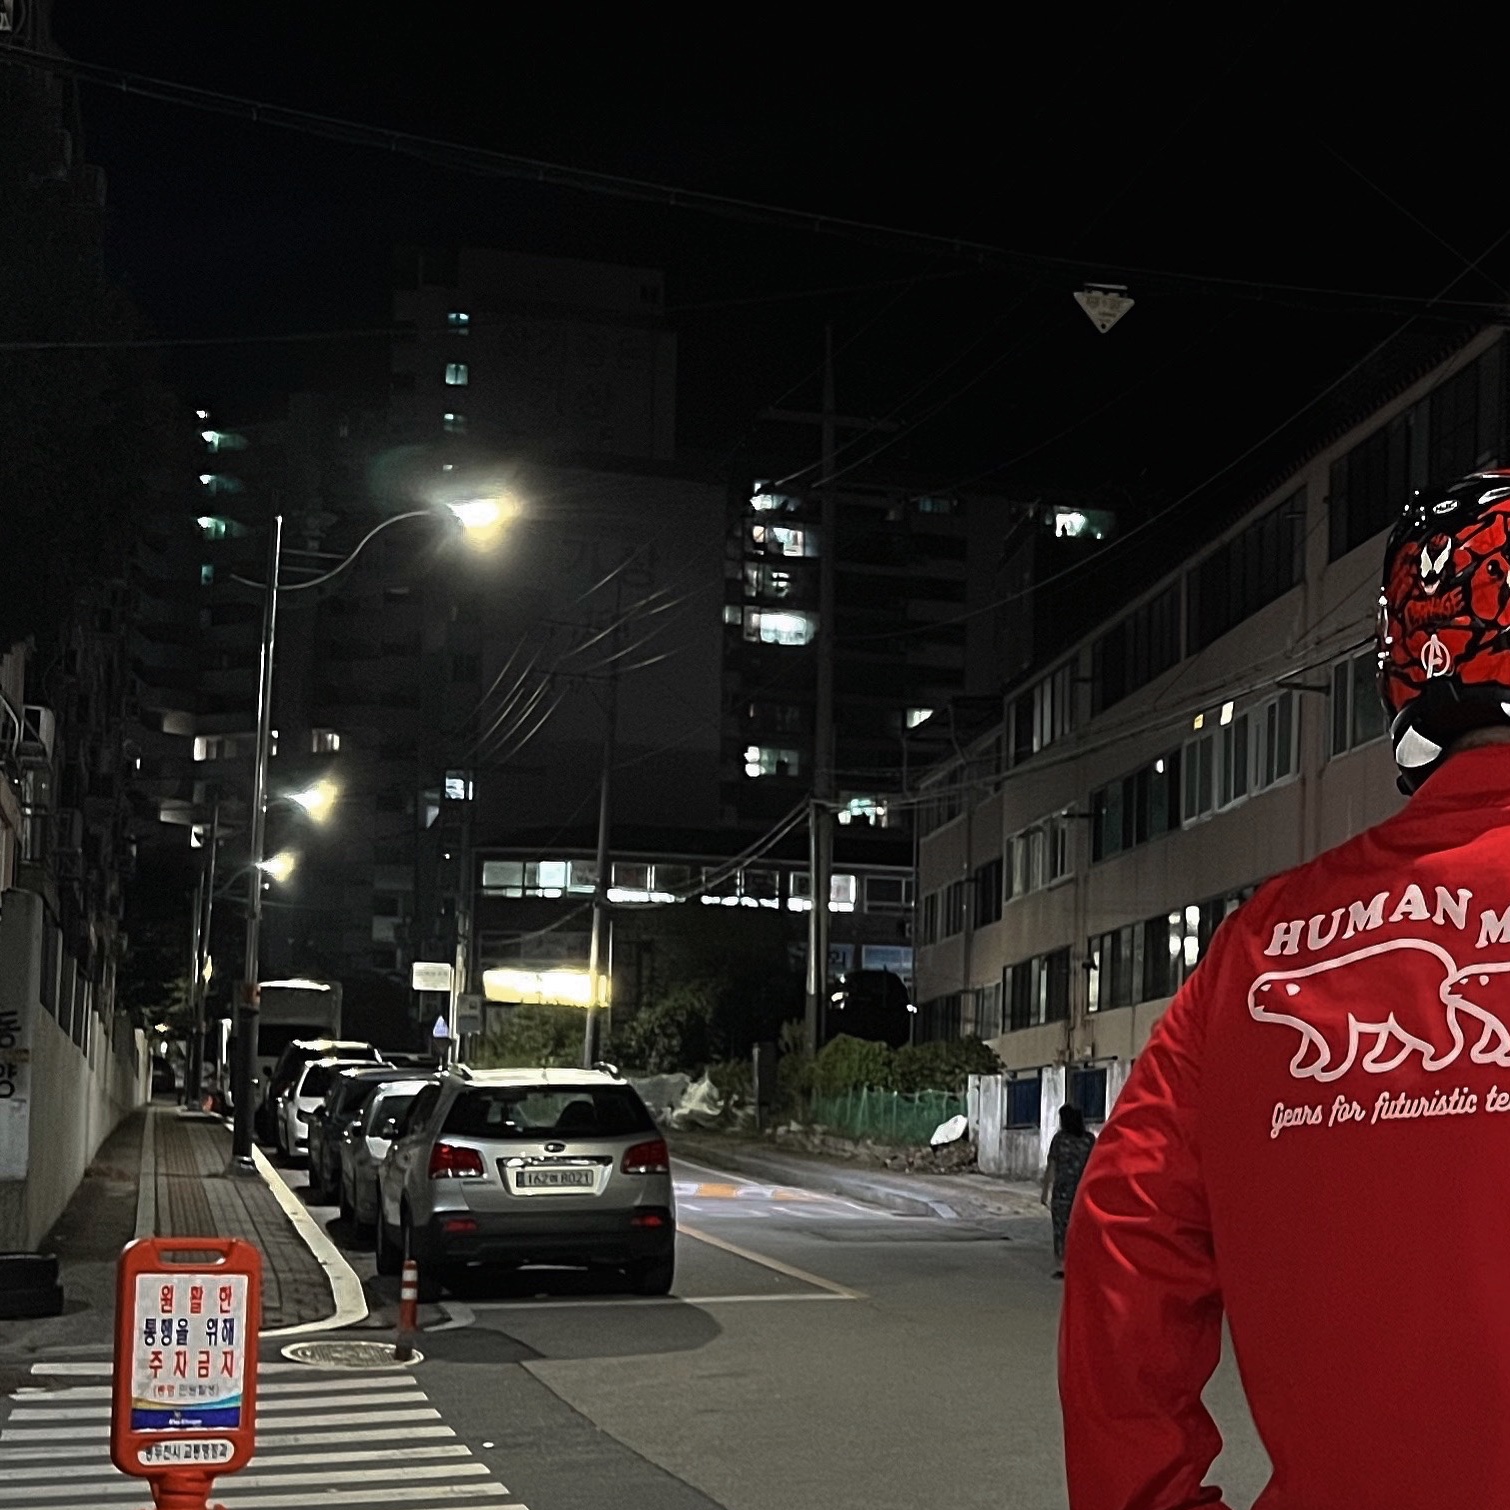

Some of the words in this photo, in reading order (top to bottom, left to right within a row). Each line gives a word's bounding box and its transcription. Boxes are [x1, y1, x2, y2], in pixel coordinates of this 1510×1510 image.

[1263, 883, 1473, 956] HUMAN
[1328, 1094, 1366, 1128] for
[1370, 1086, 1478, 1125] futuristic
[143, 1318, 189, 1346] 통행을
[206, 1317, 235, 1346] 위해
